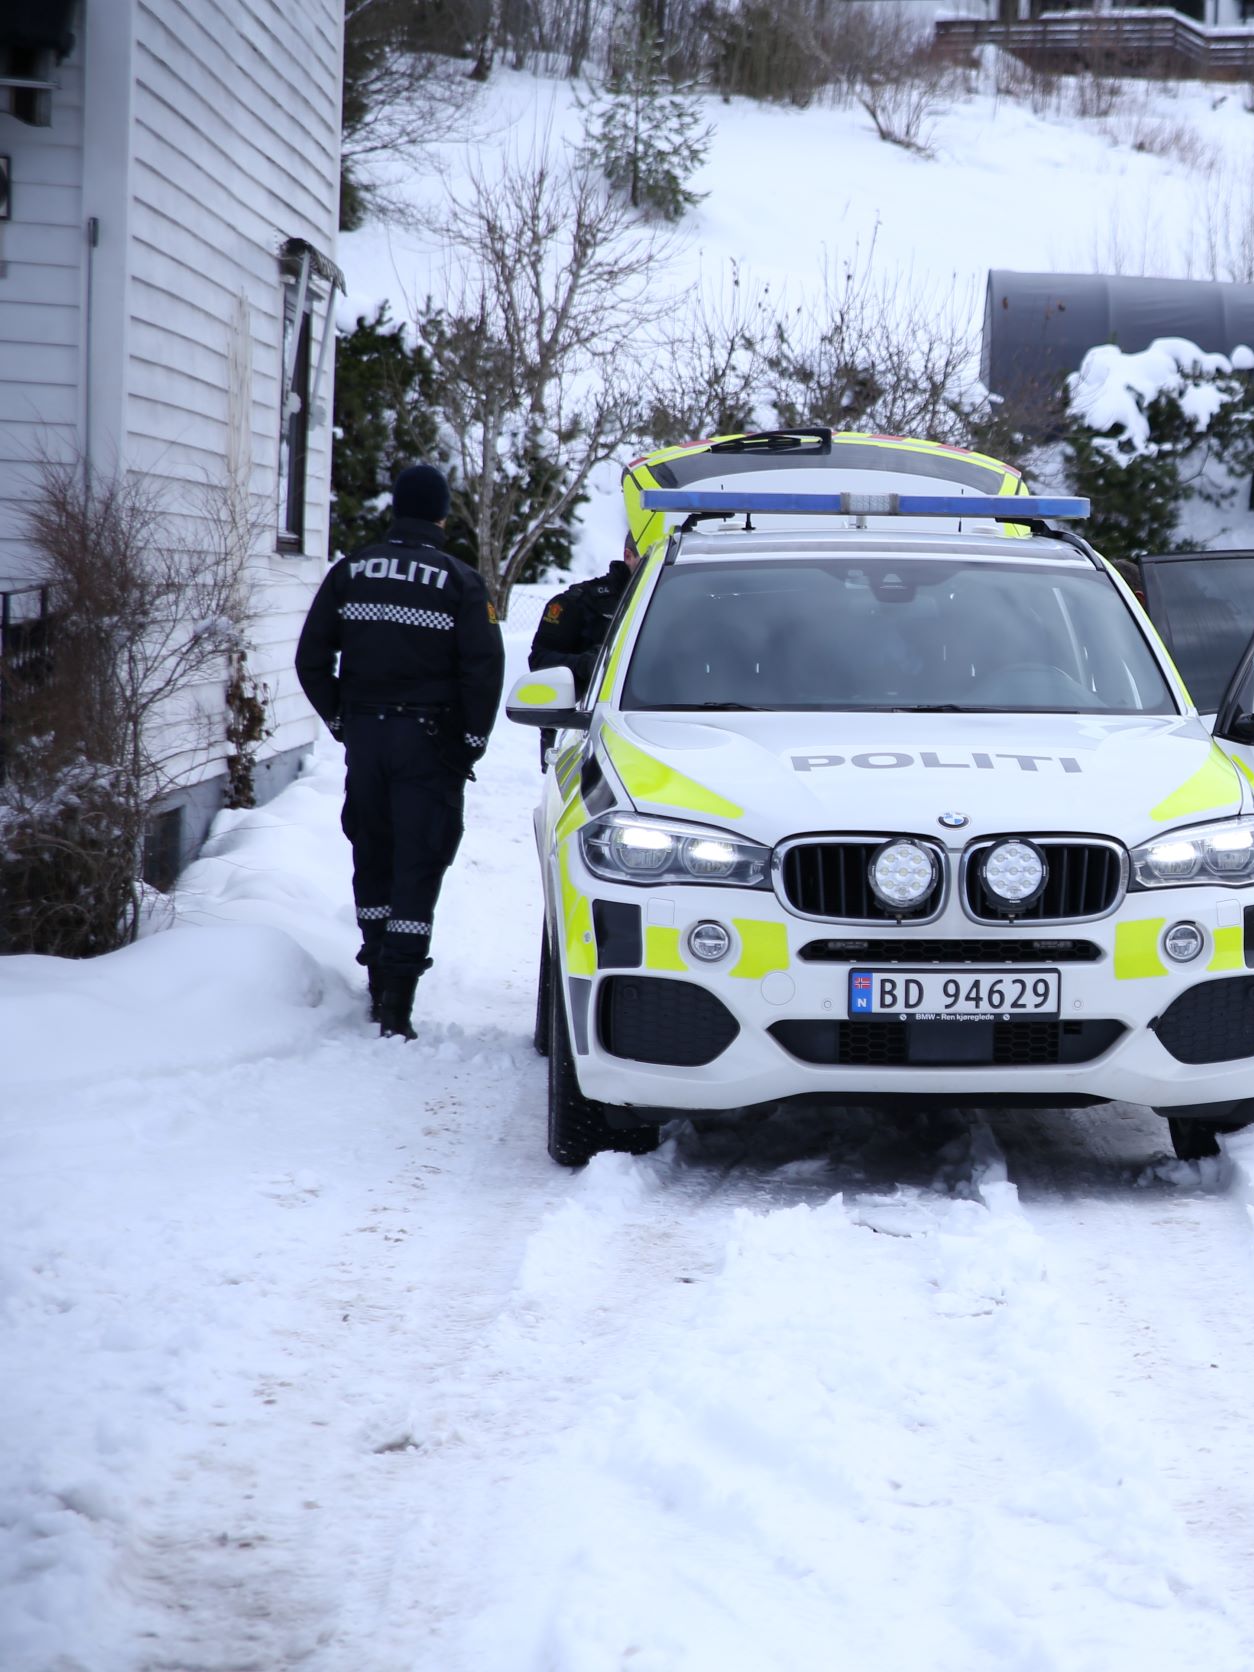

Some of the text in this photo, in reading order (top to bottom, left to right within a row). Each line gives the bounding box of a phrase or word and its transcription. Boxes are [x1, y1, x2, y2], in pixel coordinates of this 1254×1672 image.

[350, 558, 448, 589] POLITI
[790, 752, 1083, 773] POLITI
[857, 998, 867, 1008] N
[879, 978, 1051, 1010] BD 94629
[915, 1013, 936, 1021] BMW
[941, 1013, 956, 1021] Ren
